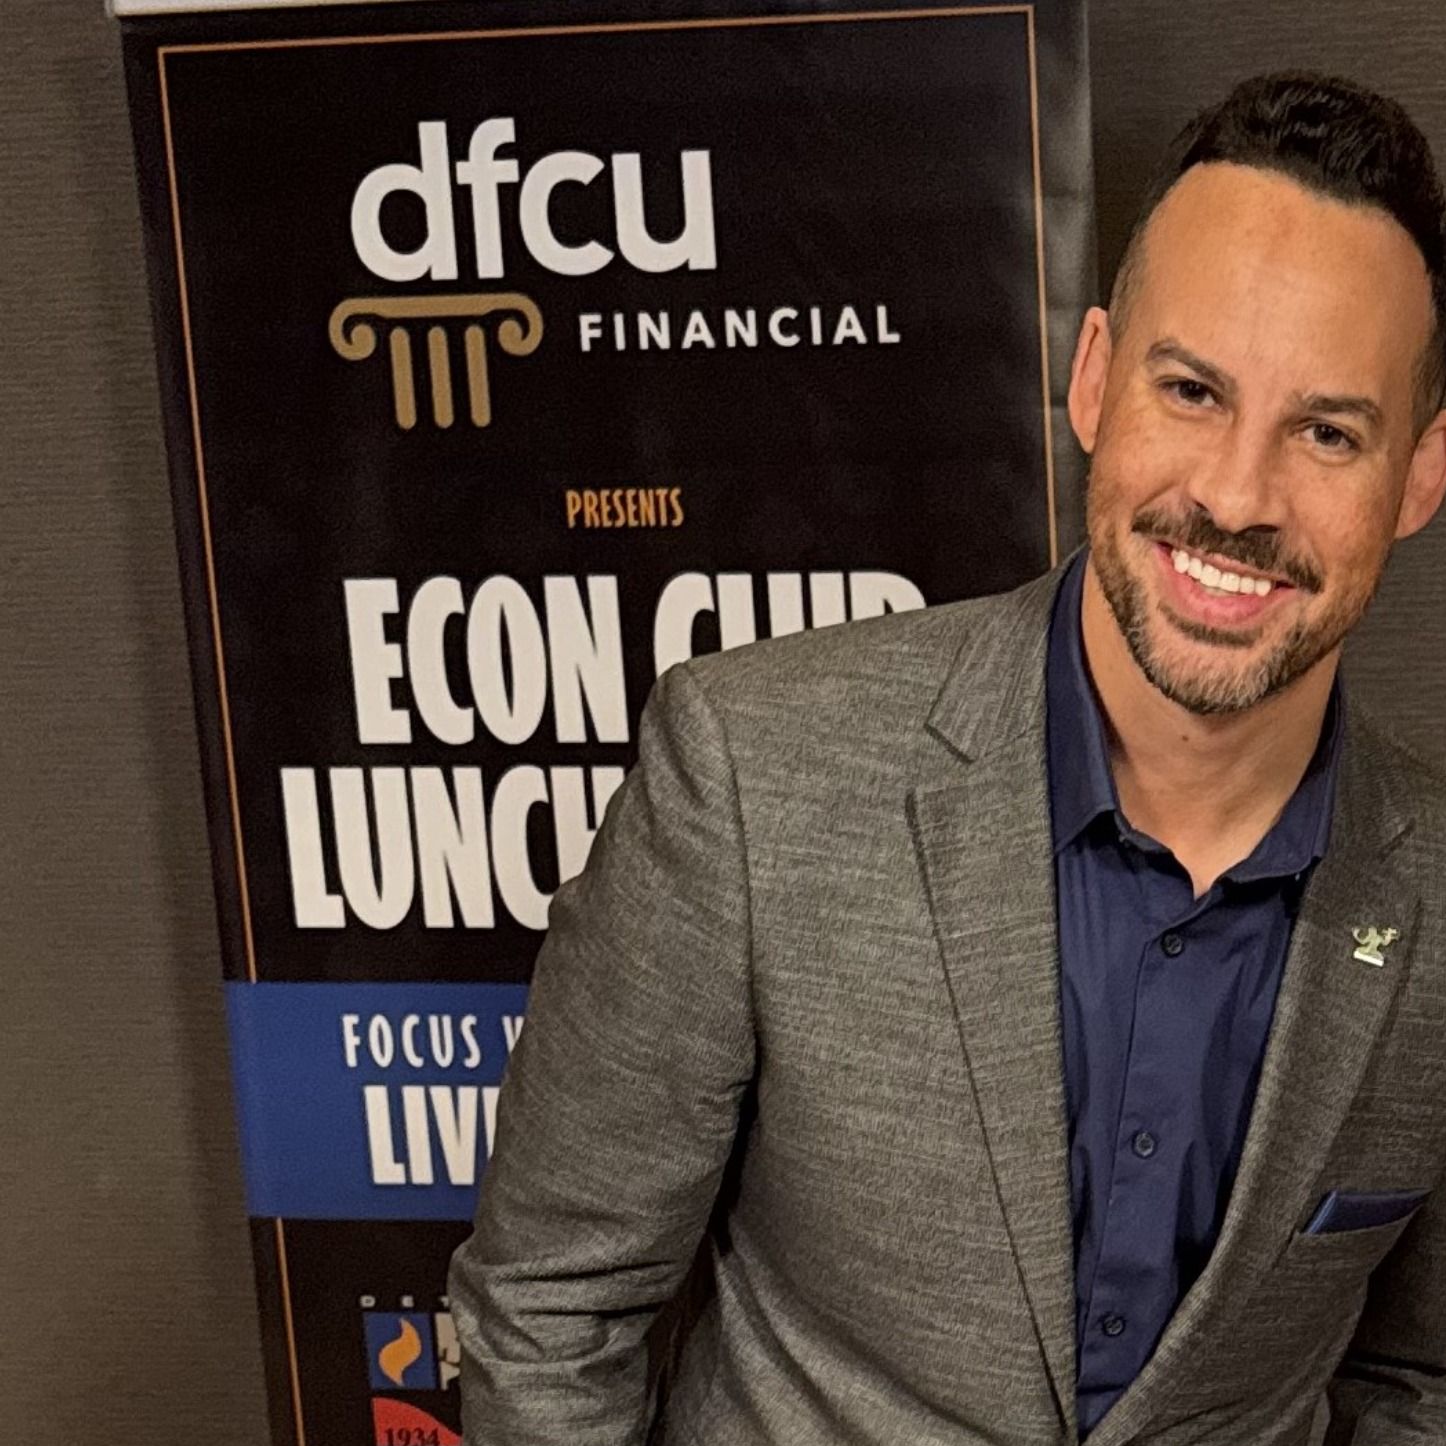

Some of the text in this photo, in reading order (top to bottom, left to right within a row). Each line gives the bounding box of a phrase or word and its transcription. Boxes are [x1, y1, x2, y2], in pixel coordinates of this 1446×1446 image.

[350, 117, 717, 281] dfcu
[578, 305, 901, 352] FINANCIAL
[565, 487, 685, 528] PRESENTS
[344, 574, 630, 745] ECON
[341, 1014, 483, 1069] FOCUS
